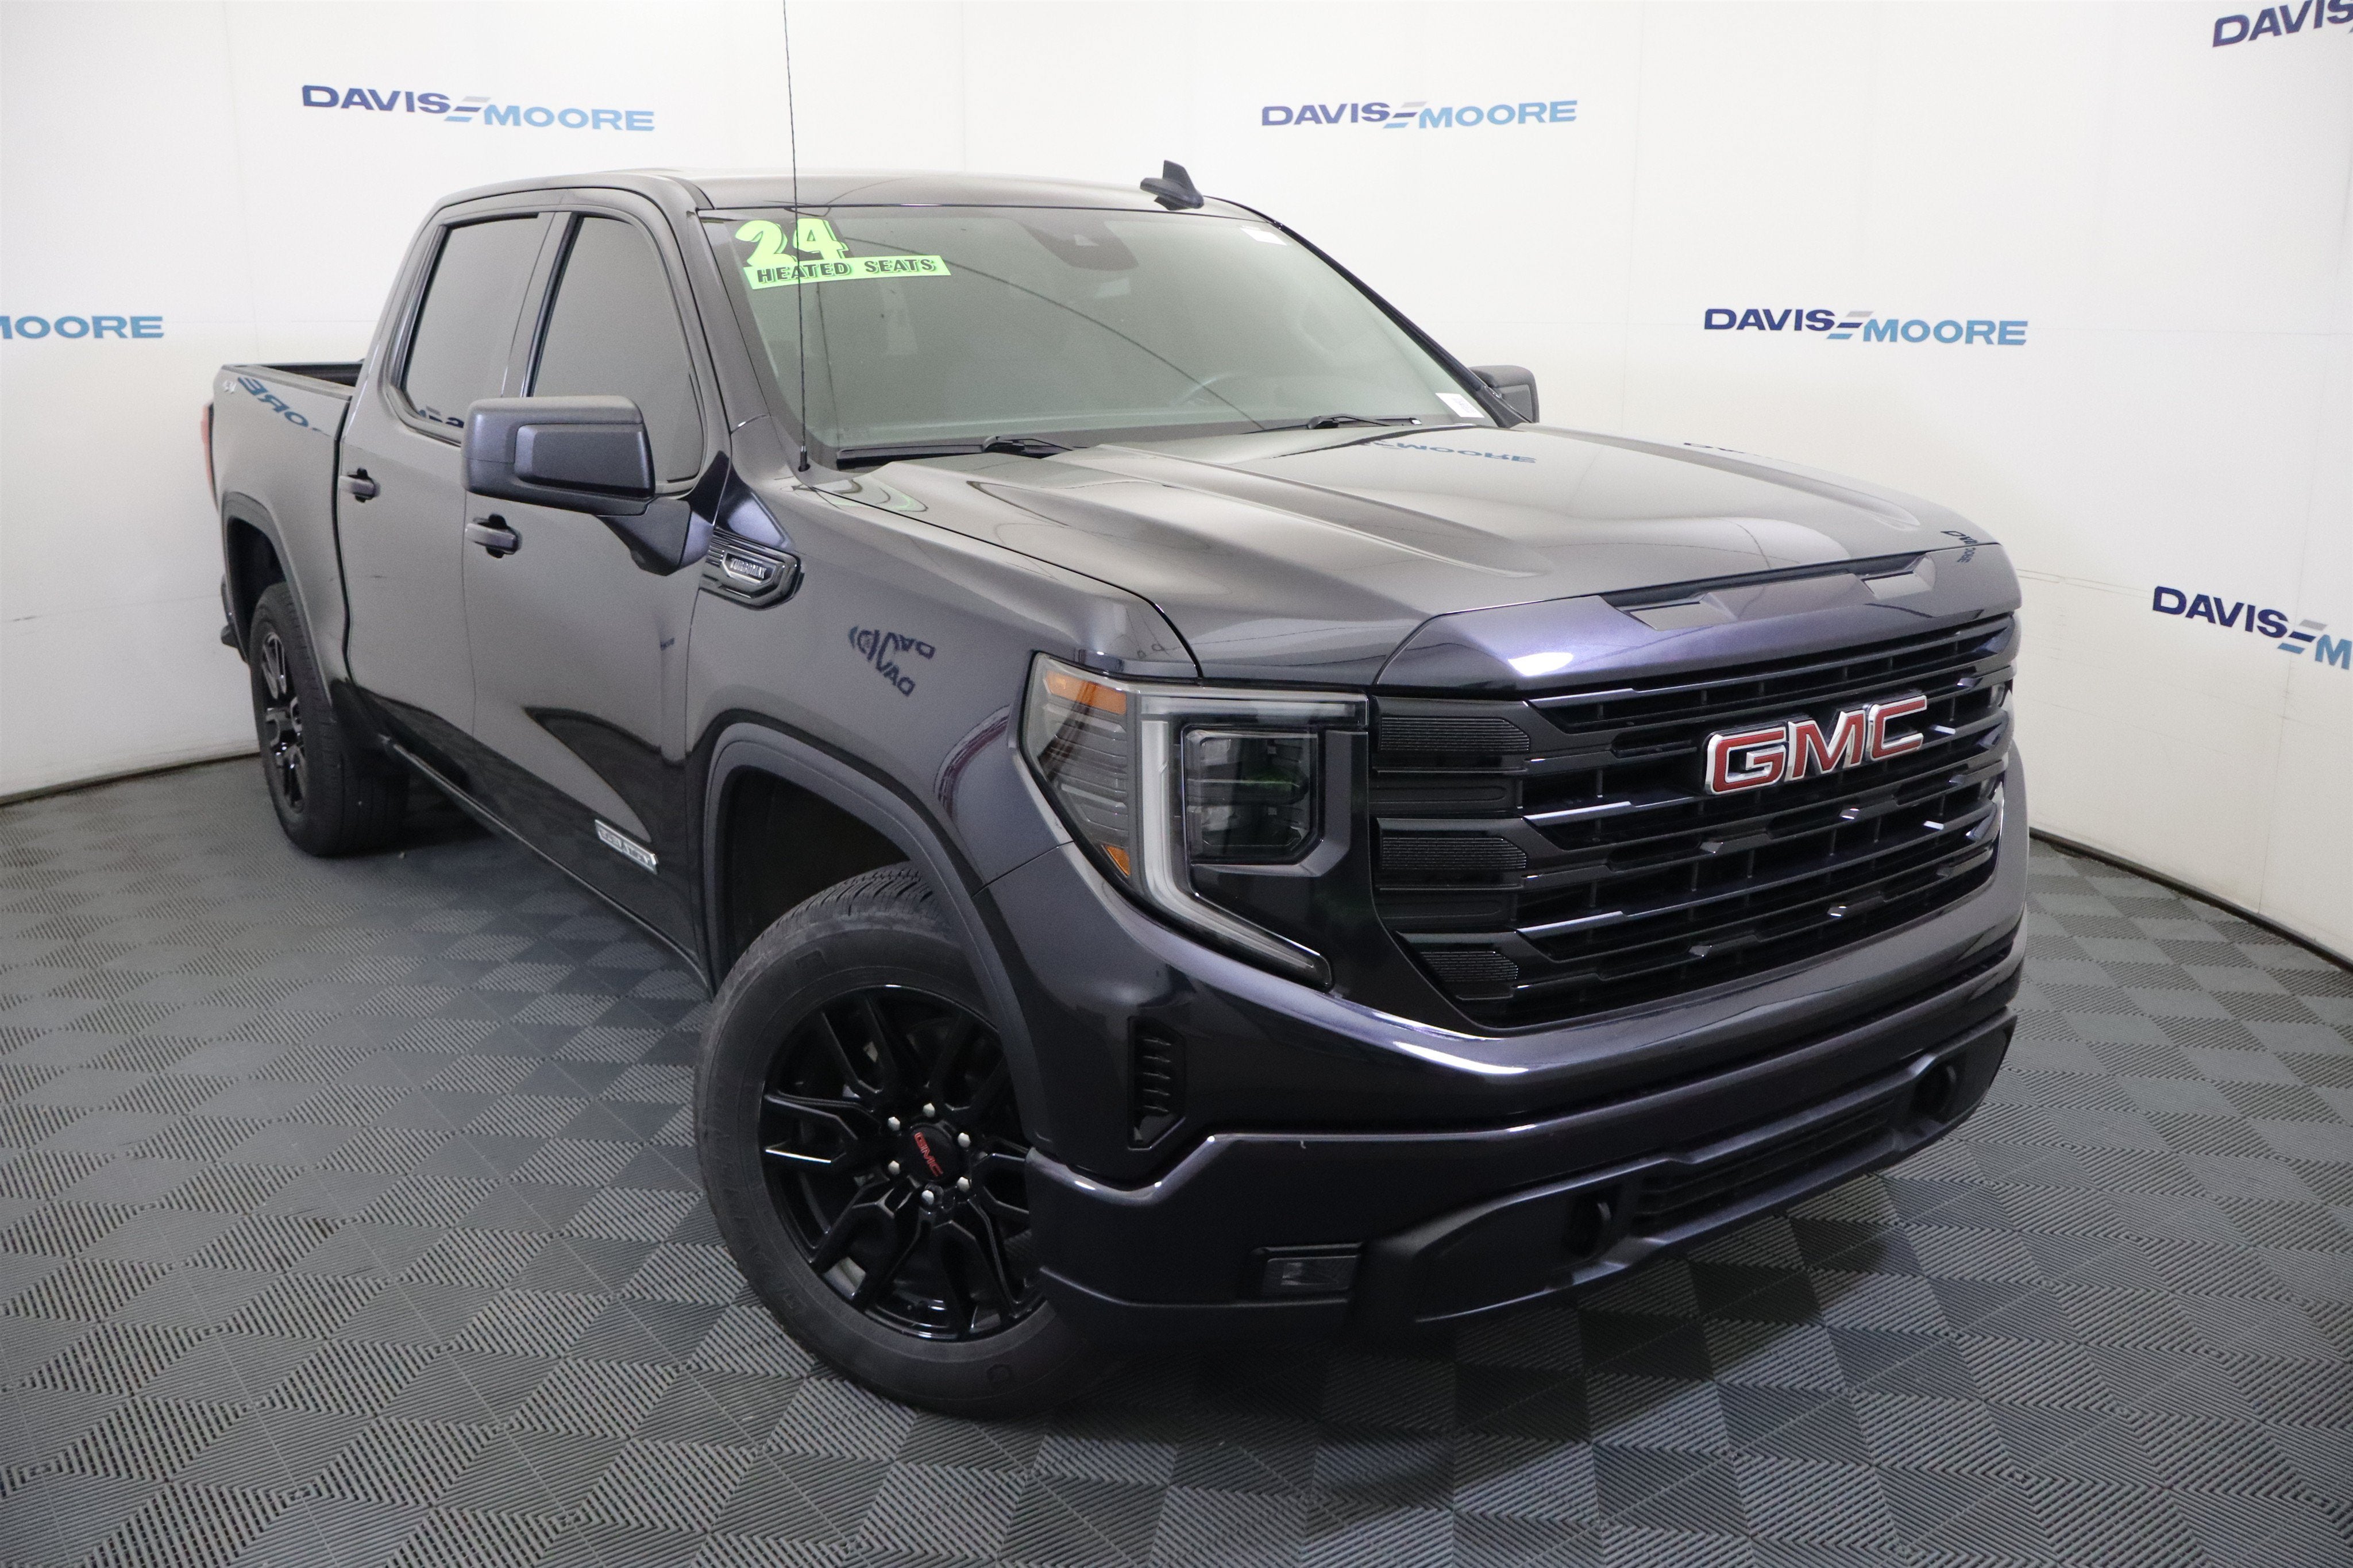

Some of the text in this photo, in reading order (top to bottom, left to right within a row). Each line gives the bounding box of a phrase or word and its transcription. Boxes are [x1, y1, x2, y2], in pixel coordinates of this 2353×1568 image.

[2212, 0, 2353, 47] DAVIS
[302, 84, 655, 132] DAVIS MOORE
[1262, 100, 1577, 129] DAVIS MOORE
[735, 218, 849, 267] 24
[757, 258, 938, 283] HEATED SEATS
[1704, 308, 2028, 345] DAVIS MOORE
[2153, 586, 2289, 639] DAVIS
[1704, 694, 1927, 795] GMC
[914, 1131, 944, 1177] GMC
